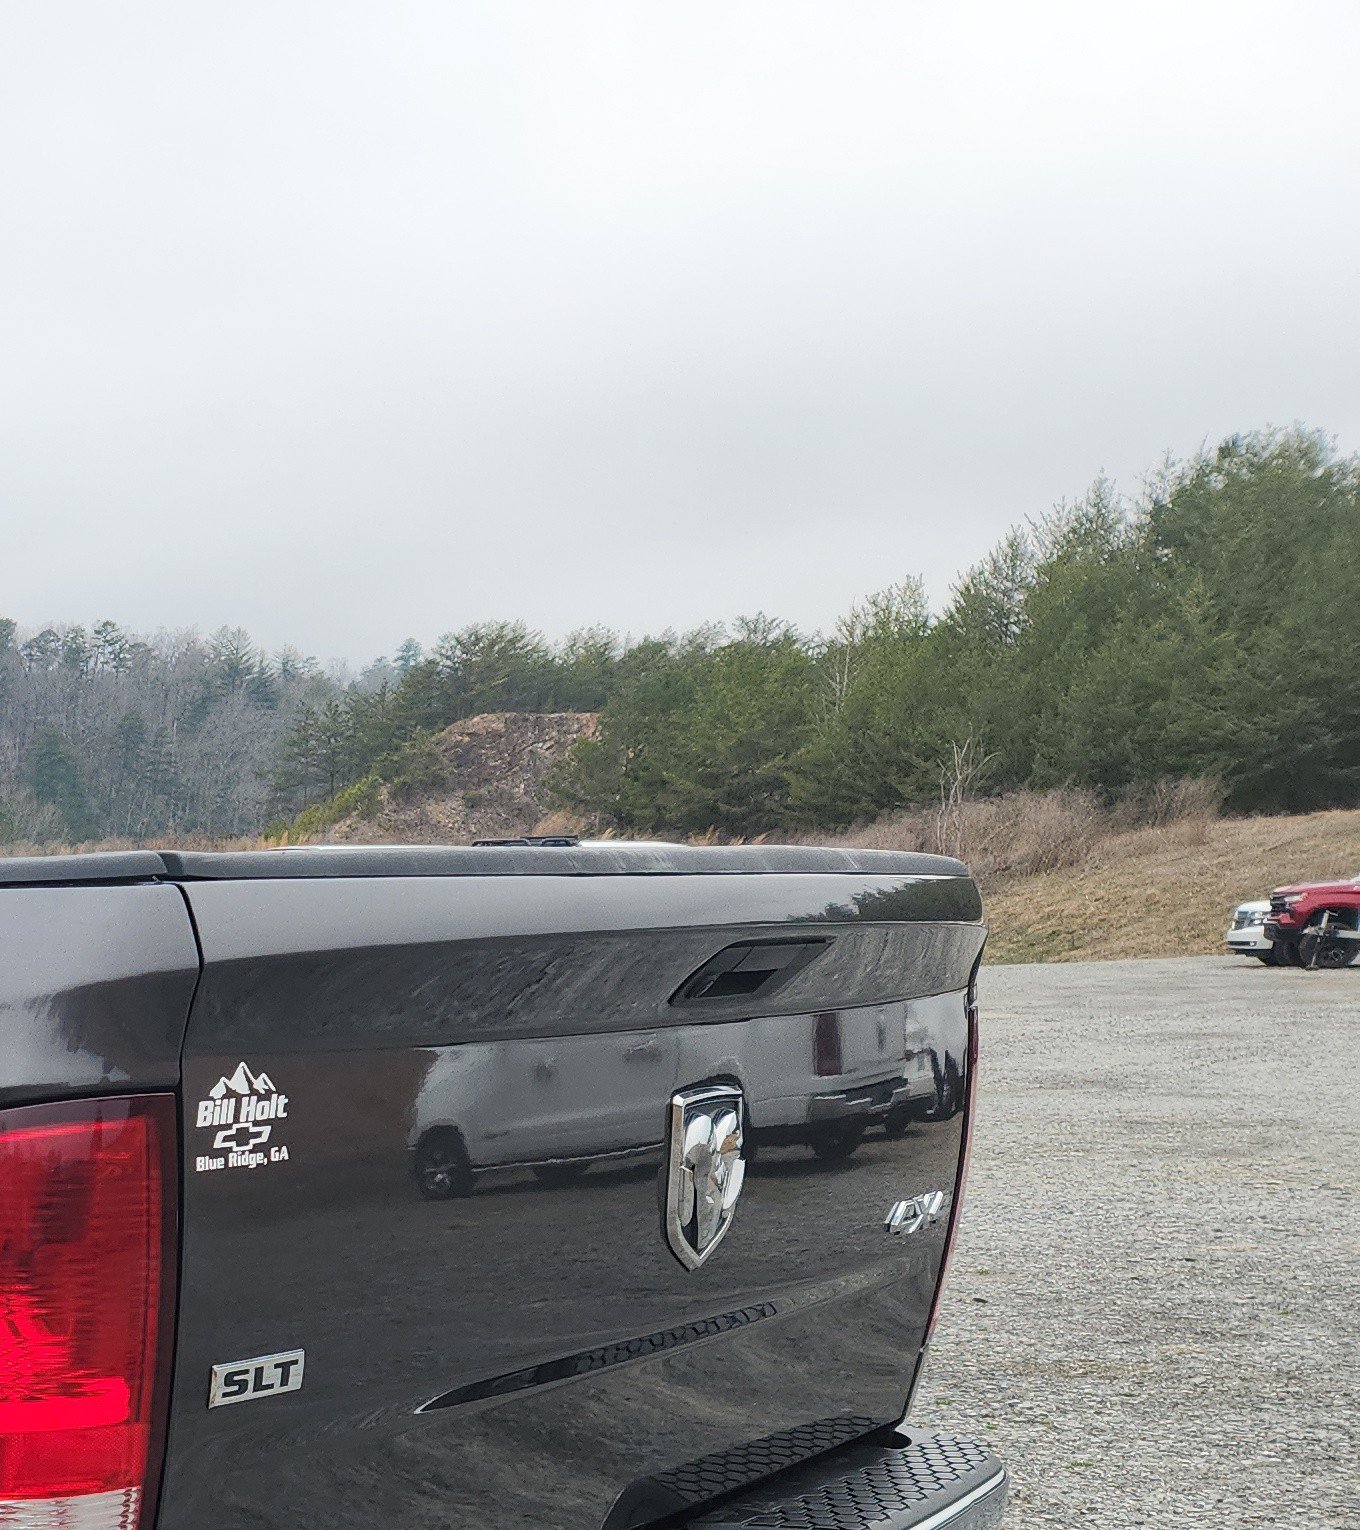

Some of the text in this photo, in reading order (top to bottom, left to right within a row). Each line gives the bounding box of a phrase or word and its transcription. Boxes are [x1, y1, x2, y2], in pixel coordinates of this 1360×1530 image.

[196, 1094, 288, 1128] Bill Holt
[196, 1146, 289, 1172] Blue Ridge, GA
[221, 1358, 299, 1398] SLT
